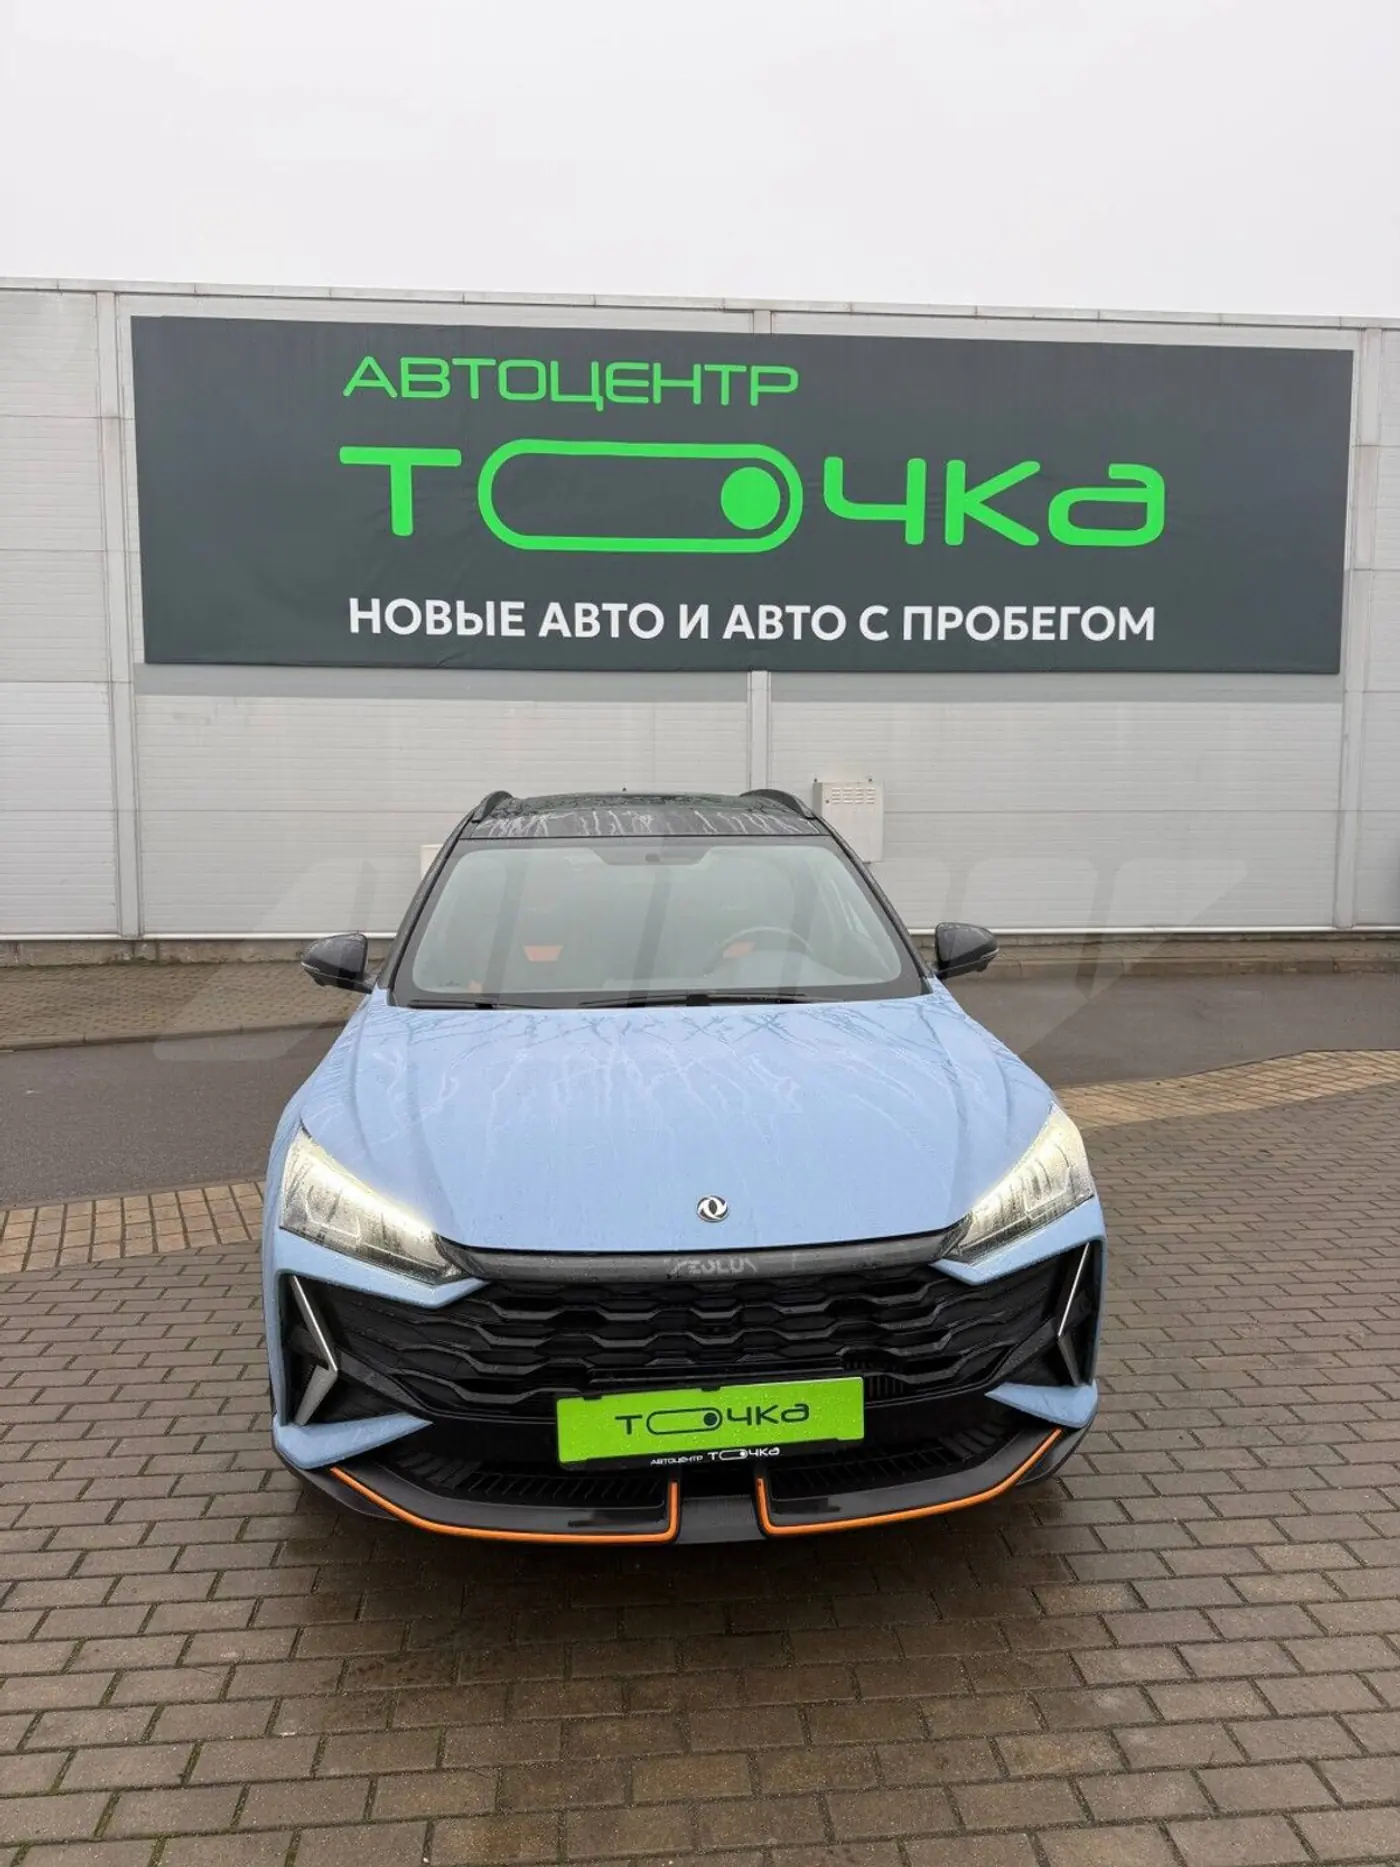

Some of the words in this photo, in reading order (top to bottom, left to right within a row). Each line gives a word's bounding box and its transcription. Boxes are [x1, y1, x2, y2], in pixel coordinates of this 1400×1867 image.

[343, 355, 799, 412] АВТОЦЕНТР
[349, 597, 526, 637] НОВЫЕ
[538, 601, 665, 640] АВТО
[679, 603, 709, 639] И
[722, 604, 847, 641] АВТО
[859, 605, 889, 642] С
[903, 605, 1156, 642] ПРОБЕГОМ
